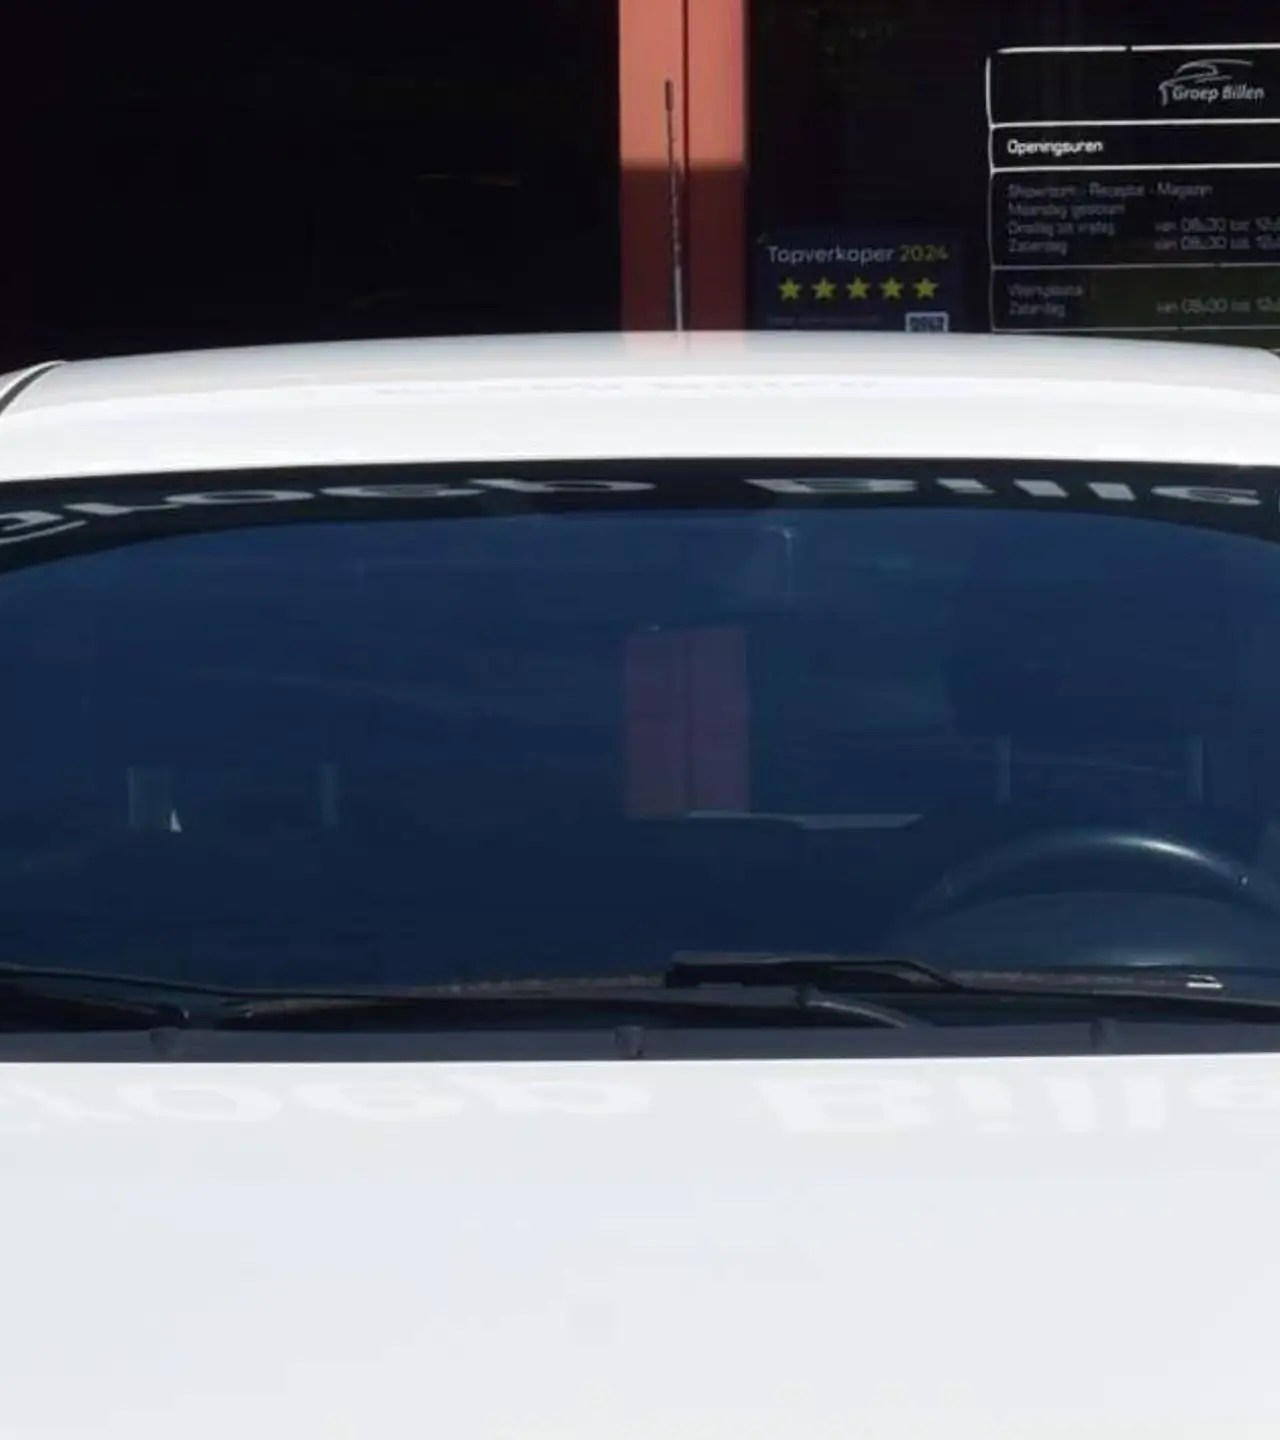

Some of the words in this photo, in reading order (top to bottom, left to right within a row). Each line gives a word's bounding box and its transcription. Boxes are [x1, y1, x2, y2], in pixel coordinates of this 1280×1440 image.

[1171, 84, 1219, 103] Groep
[1221, 83, 1265, 100] Billen
[1007, 138, 1103, 157] Openingsuren
[767, 245, 895, 267] Topverkoper
[898, 244, 949, 263] 2024
